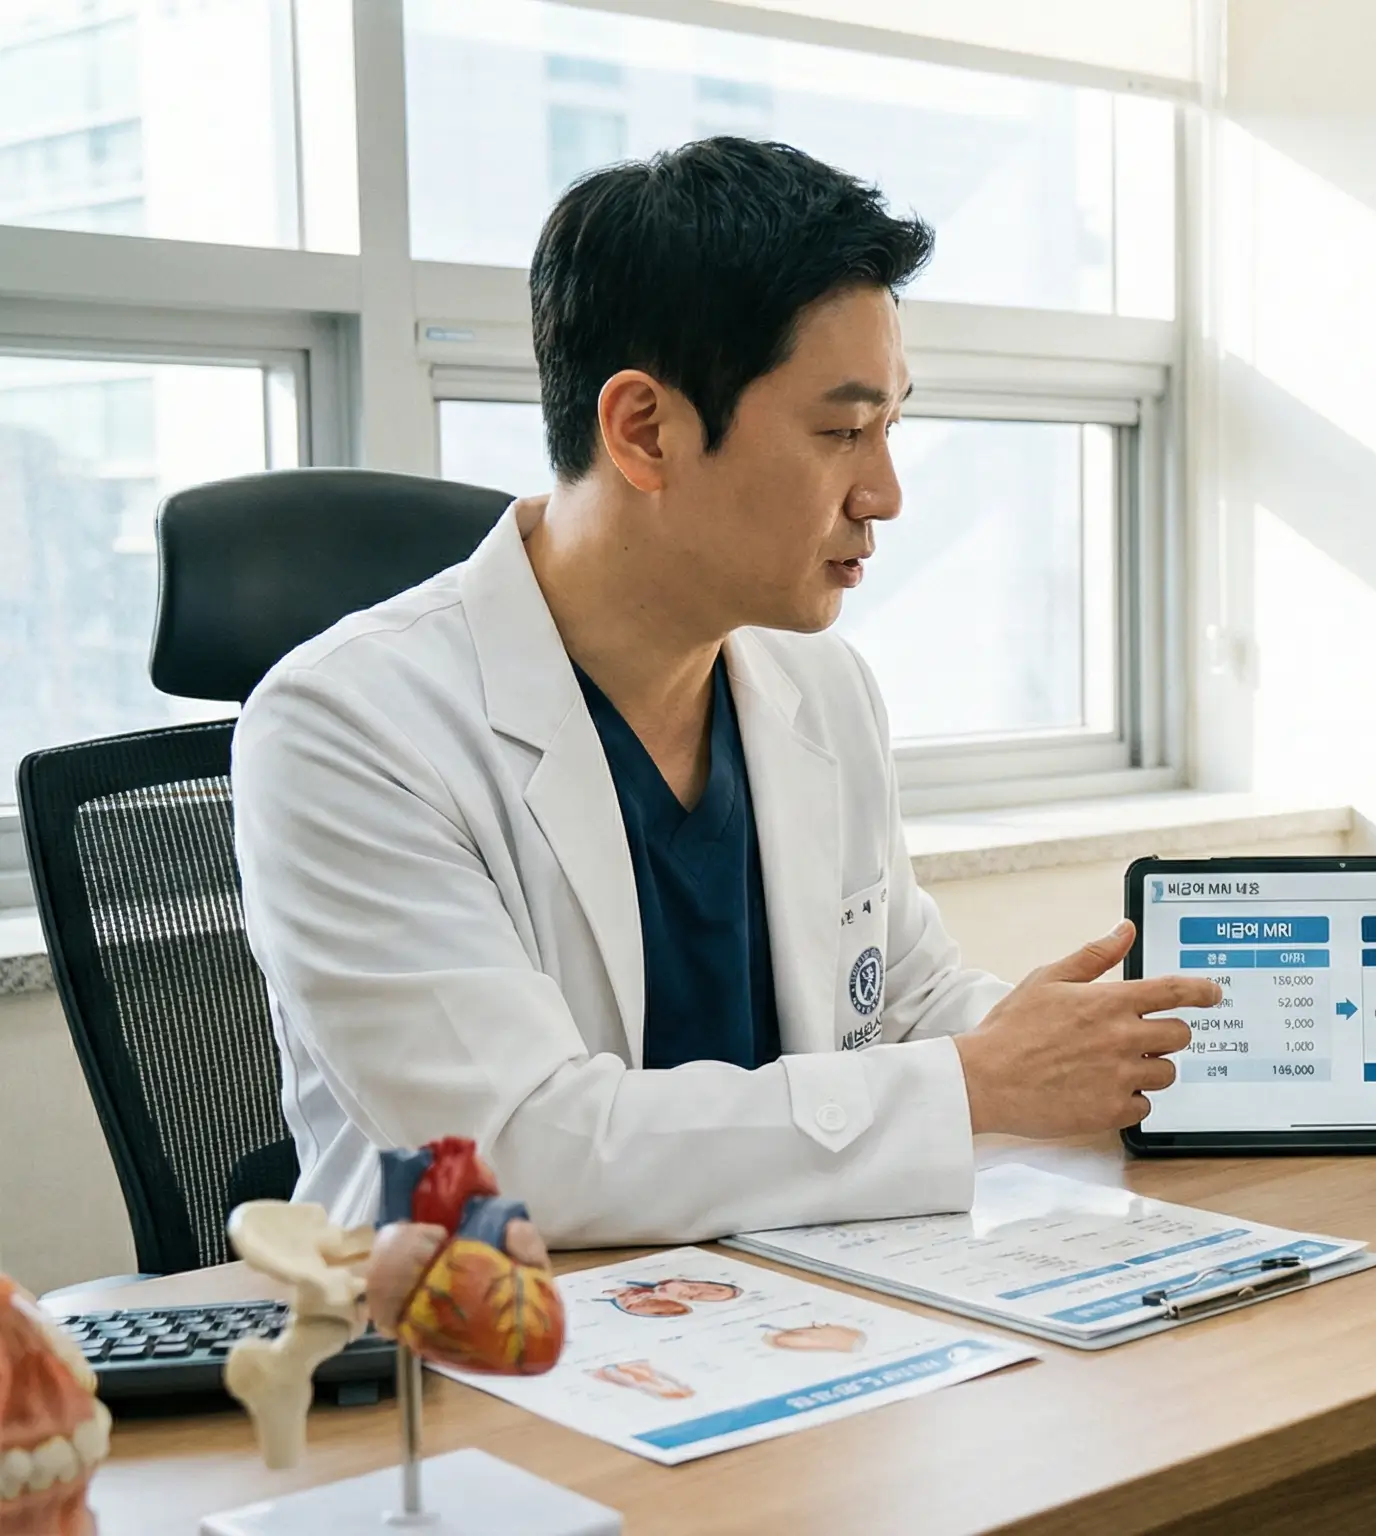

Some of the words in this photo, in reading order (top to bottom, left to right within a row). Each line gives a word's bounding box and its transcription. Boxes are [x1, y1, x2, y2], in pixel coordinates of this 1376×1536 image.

[1263, 923, 1292, 937] MRI
[1223, 1019, 1244, 1029] MRI
[1284, 1018, 1314, 1030] 9,000
